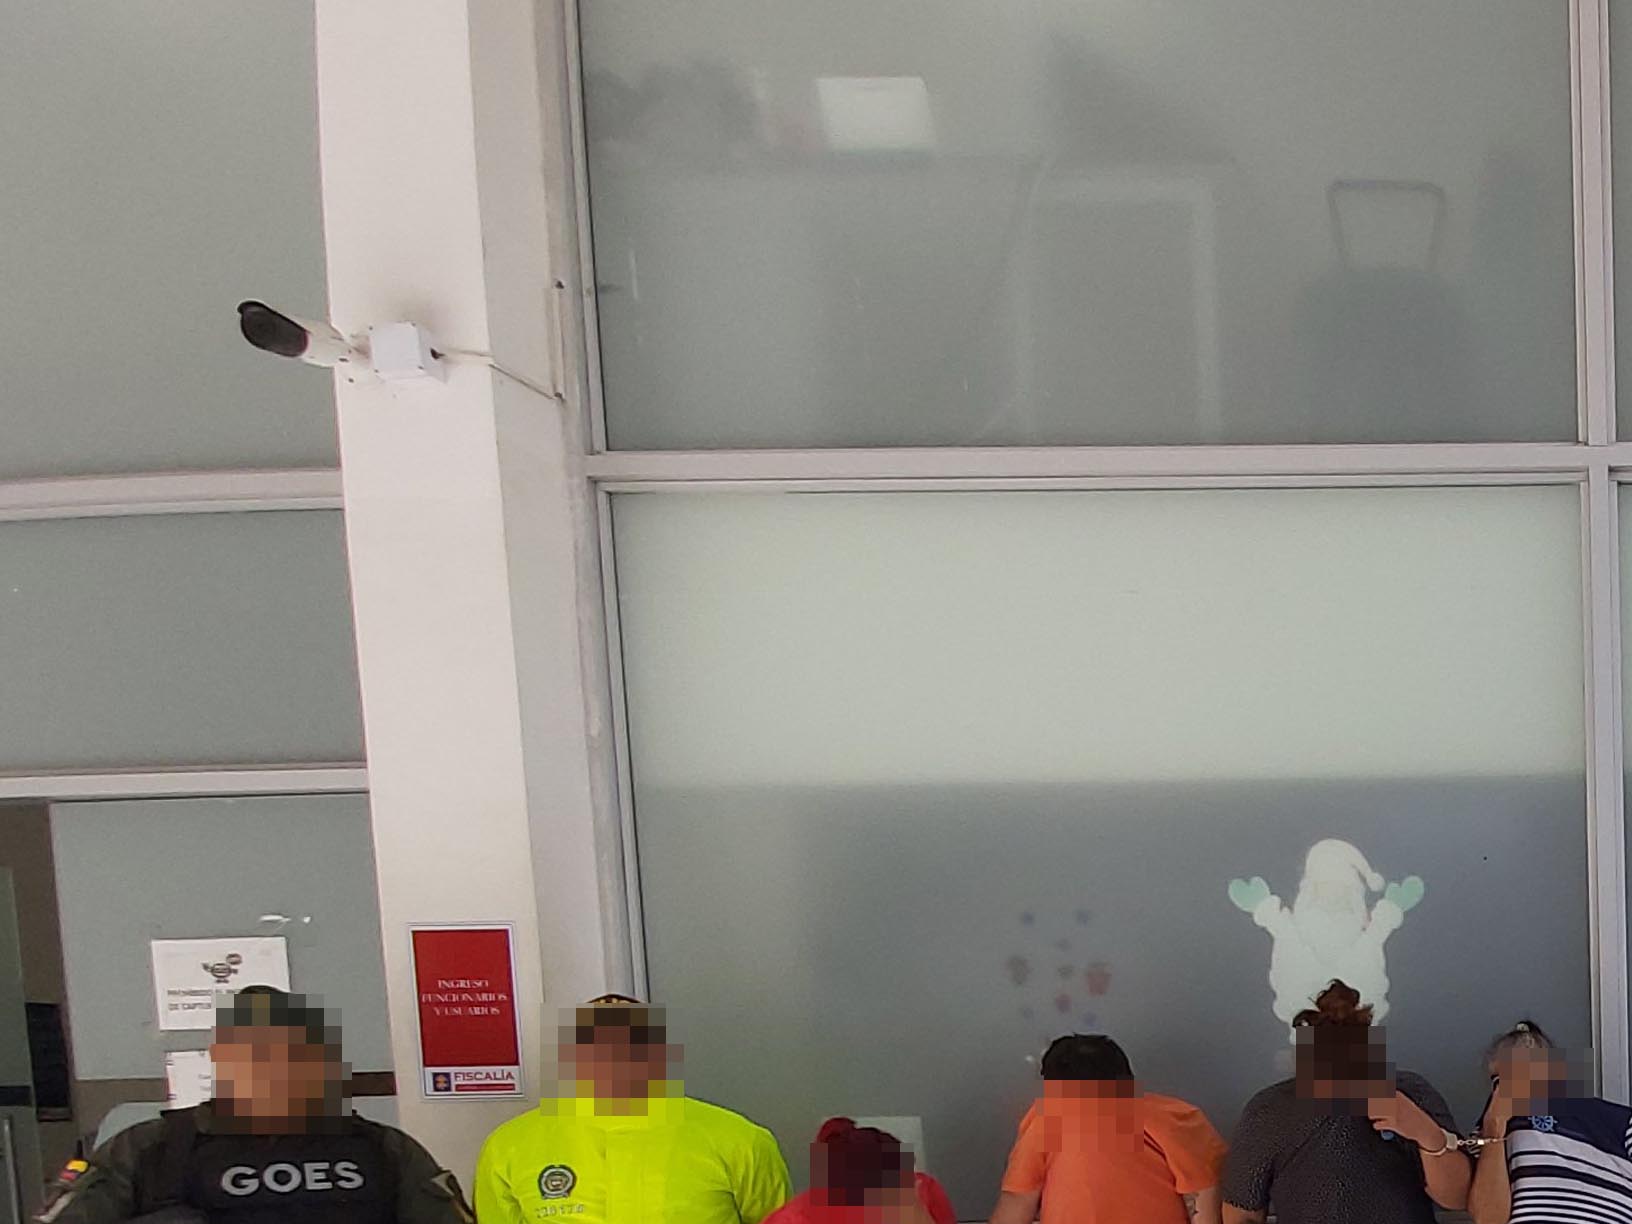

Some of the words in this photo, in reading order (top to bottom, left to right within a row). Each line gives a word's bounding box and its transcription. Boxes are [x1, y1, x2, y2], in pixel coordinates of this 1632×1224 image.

[437, 979, 489, 990] INGRESO
[421, 992, 508, 1003] FUNCIONARIOS
[432, 1005, 442, 1016] Y
[444, 1005, 500, 1016] USUARIOS
[453, 1069, 516, 1081] FISCALÍA
[220, 1160, 365, 1197] GOES
